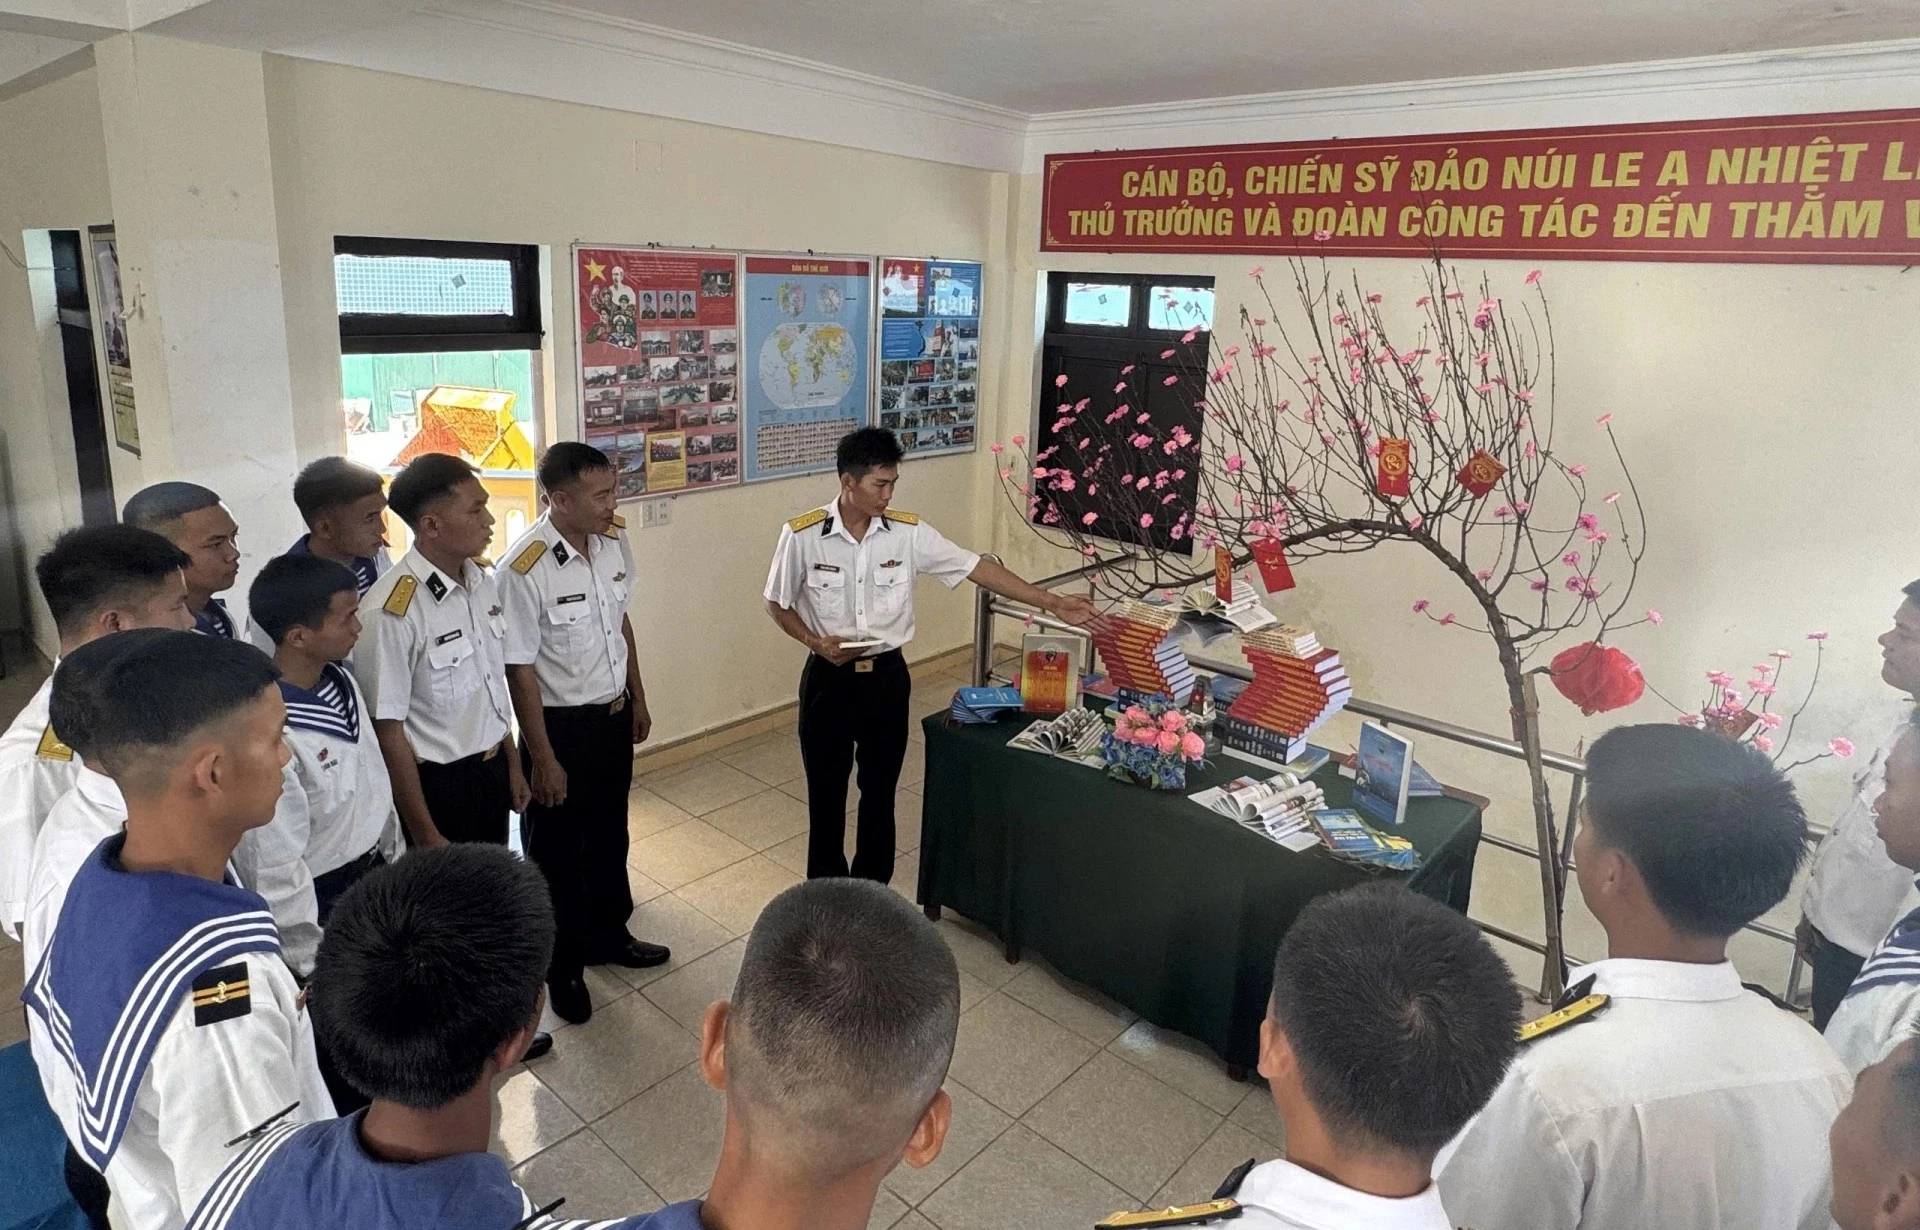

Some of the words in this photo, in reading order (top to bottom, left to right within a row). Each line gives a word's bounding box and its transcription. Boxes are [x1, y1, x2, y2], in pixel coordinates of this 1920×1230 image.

[1121, 164, 1178, 198] CÁN
[1187, 161, 1234, 201] BỘ,
[1245, 154, 1343, 195] CHIẾN
[1353, 155, 1401, 192] SỸ
[1411, 147, 1489, 191] ĐẢO
[1501, 148, 1577, 189] NÚI
[1590, 151, 1644, 188] LE
[1656, 150, 1689, 186] A
[1706, 136, 1868, 192] NHIỆT
[1068, 201, 1115, 236] THỦ
[1123, 199, 1233, 236] TRƯỞNG
[1244, 202, 1282, 236] VÀ
[1292, 201, 1387, 237] ĐOÀN
[1398, 199, 1504, 238] CÔNG
[1519, 197, 1599, 238] TÁC
[1613, 191, 1712, 239] ĐẾN
